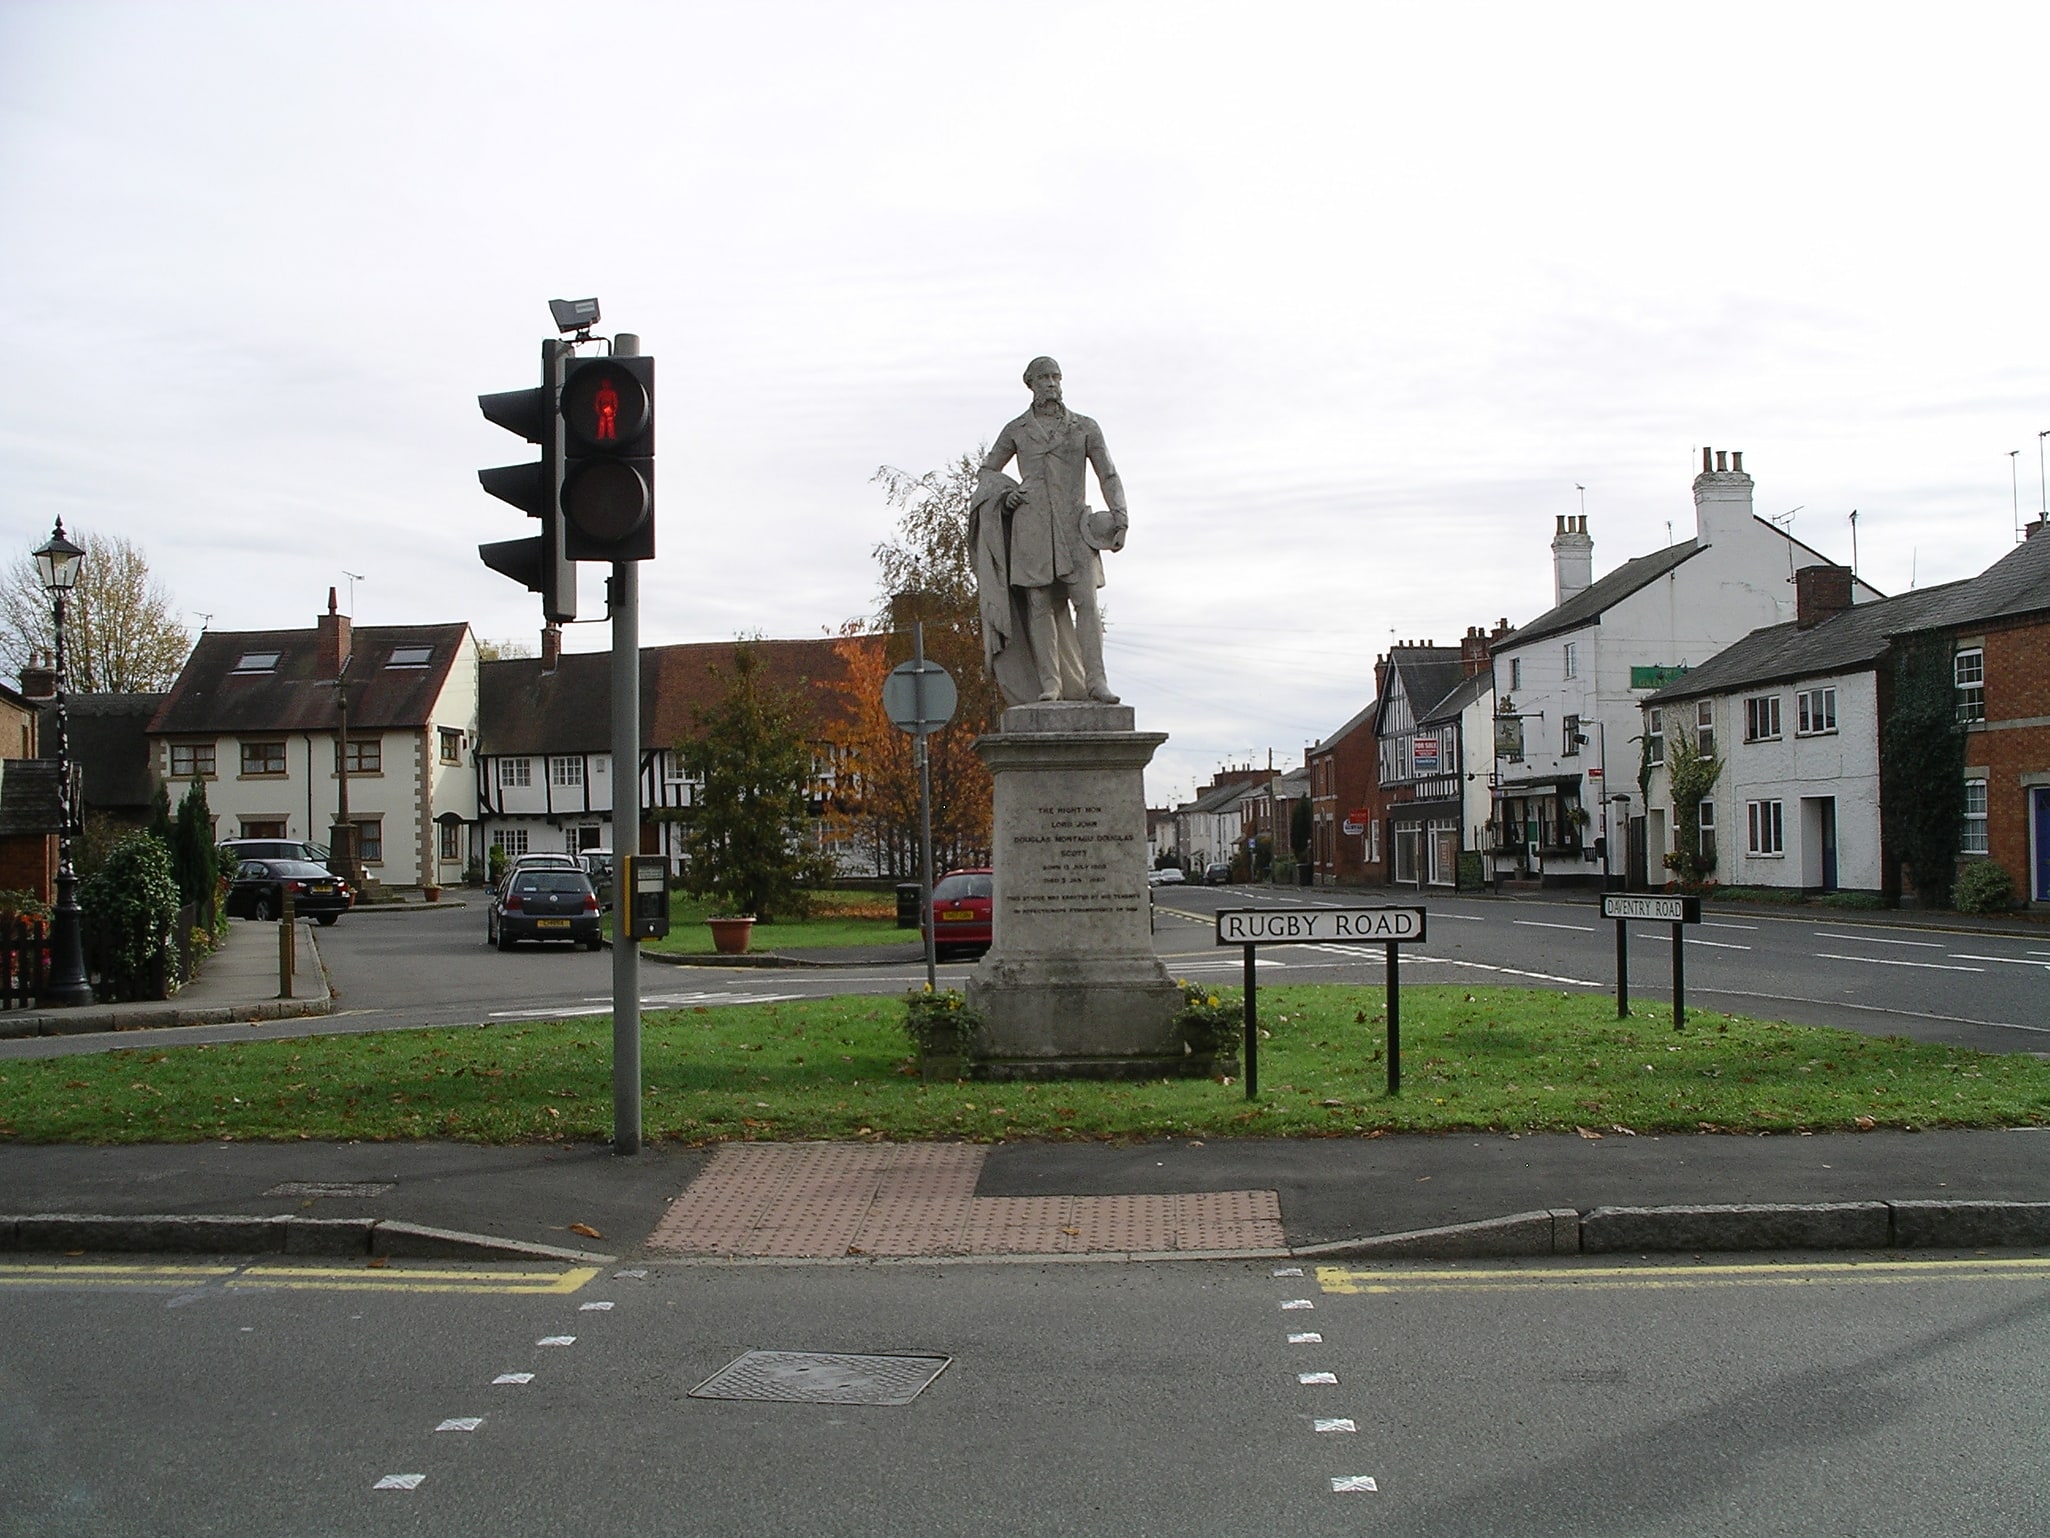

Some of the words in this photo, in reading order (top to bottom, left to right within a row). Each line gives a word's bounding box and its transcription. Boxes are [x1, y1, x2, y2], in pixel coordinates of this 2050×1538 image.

[1097, 834, 1134, 842] DOUGLAS
[1608, 899, 1651, 916] DAVENTRY
[1655, 901, 1681, 917] ROAD
[1229, 915, 1320, 937] RUGBY
[1336, 914, 1412, 935] ROAD
